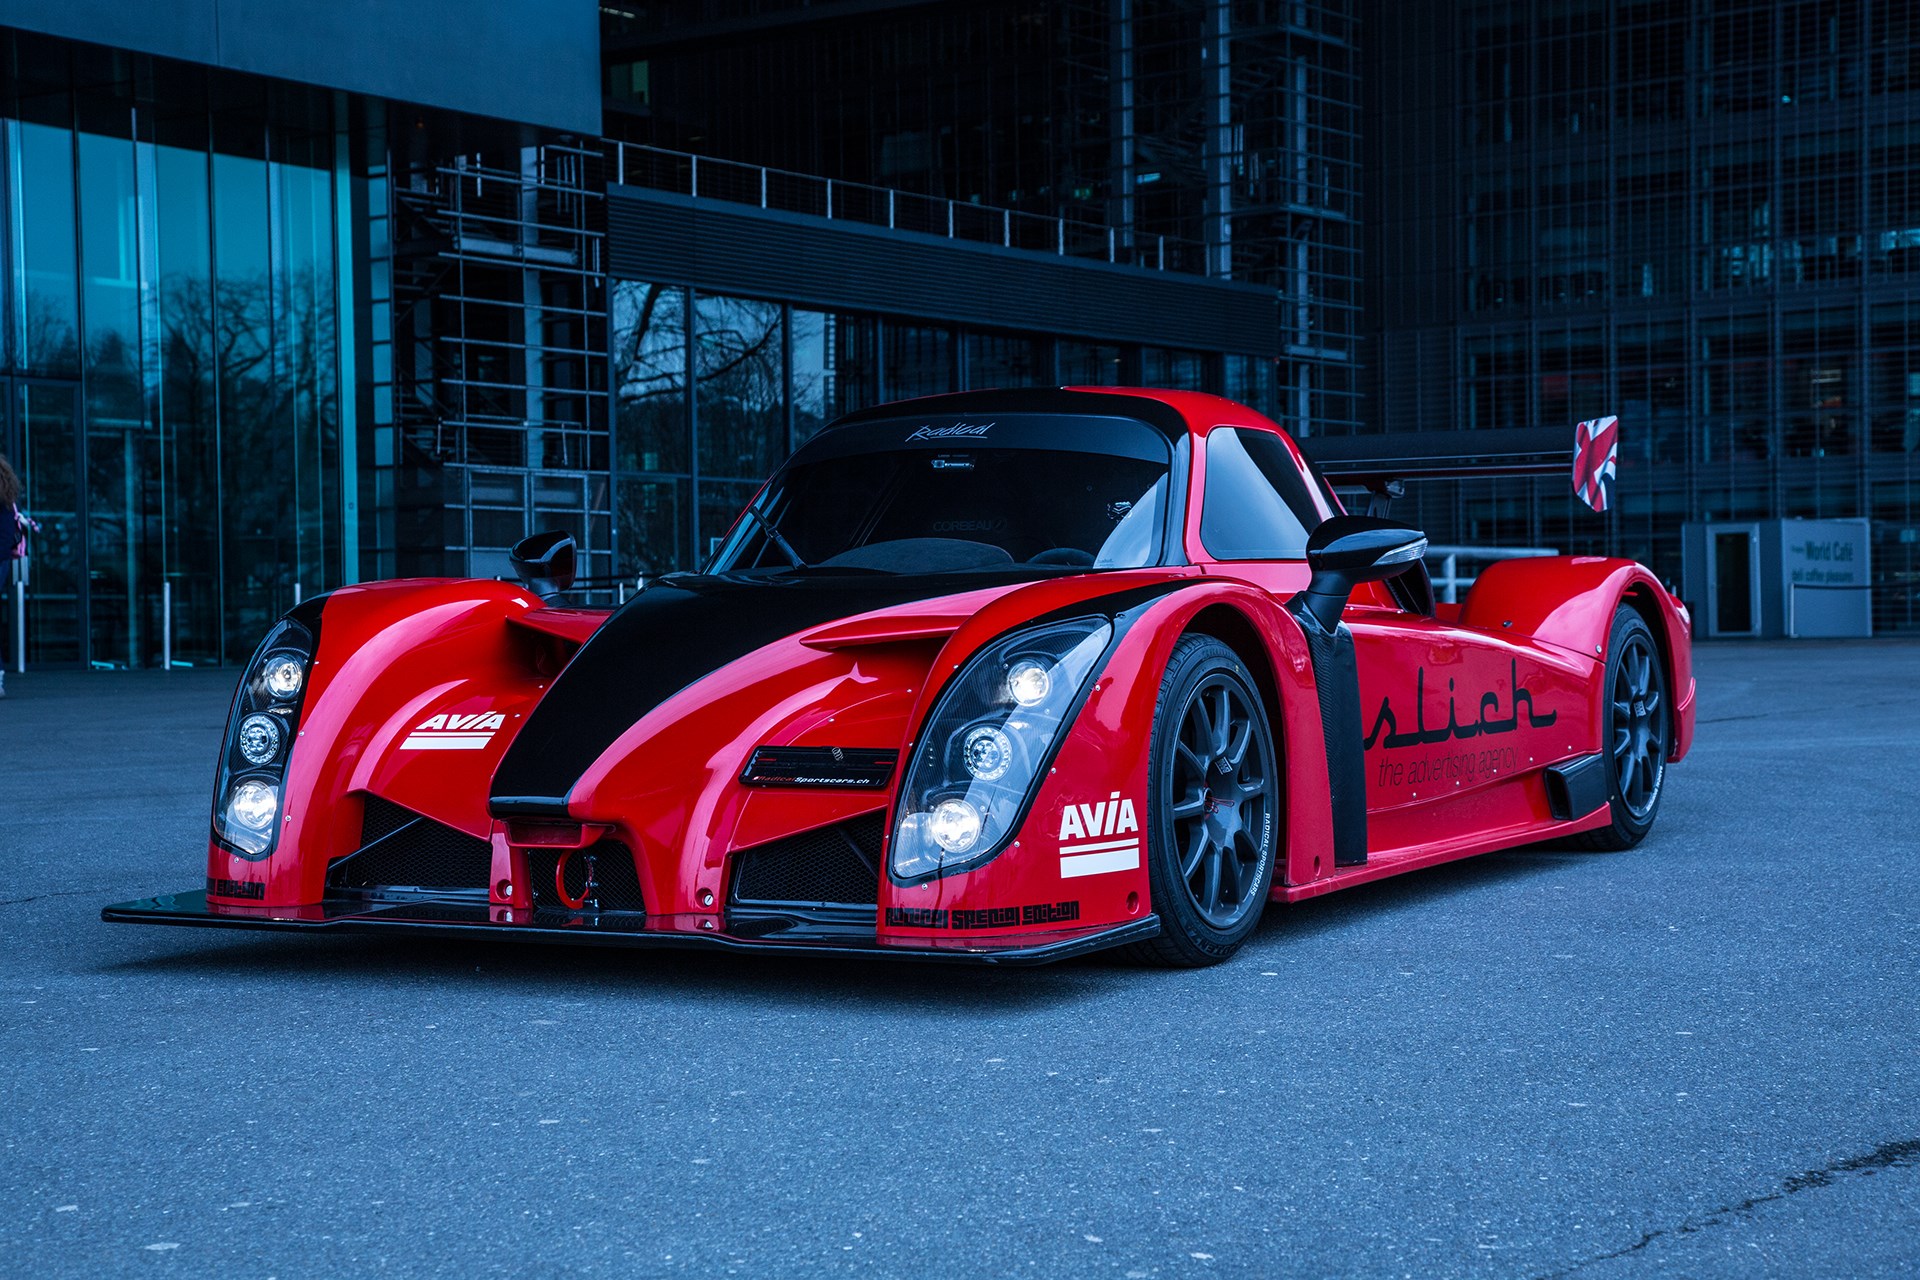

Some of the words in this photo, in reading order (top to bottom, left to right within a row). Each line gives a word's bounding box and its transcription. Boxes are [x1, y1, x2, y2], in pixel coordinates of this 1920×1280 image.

[905, 422, 996, 442] Radical
[1379, 756, 1404, 787] the
[1408, 752, 1476, 782] advertising
[1480, 747, 1518, 779] agency
[1250, 850, 1268, 896] SPORTSCARS
